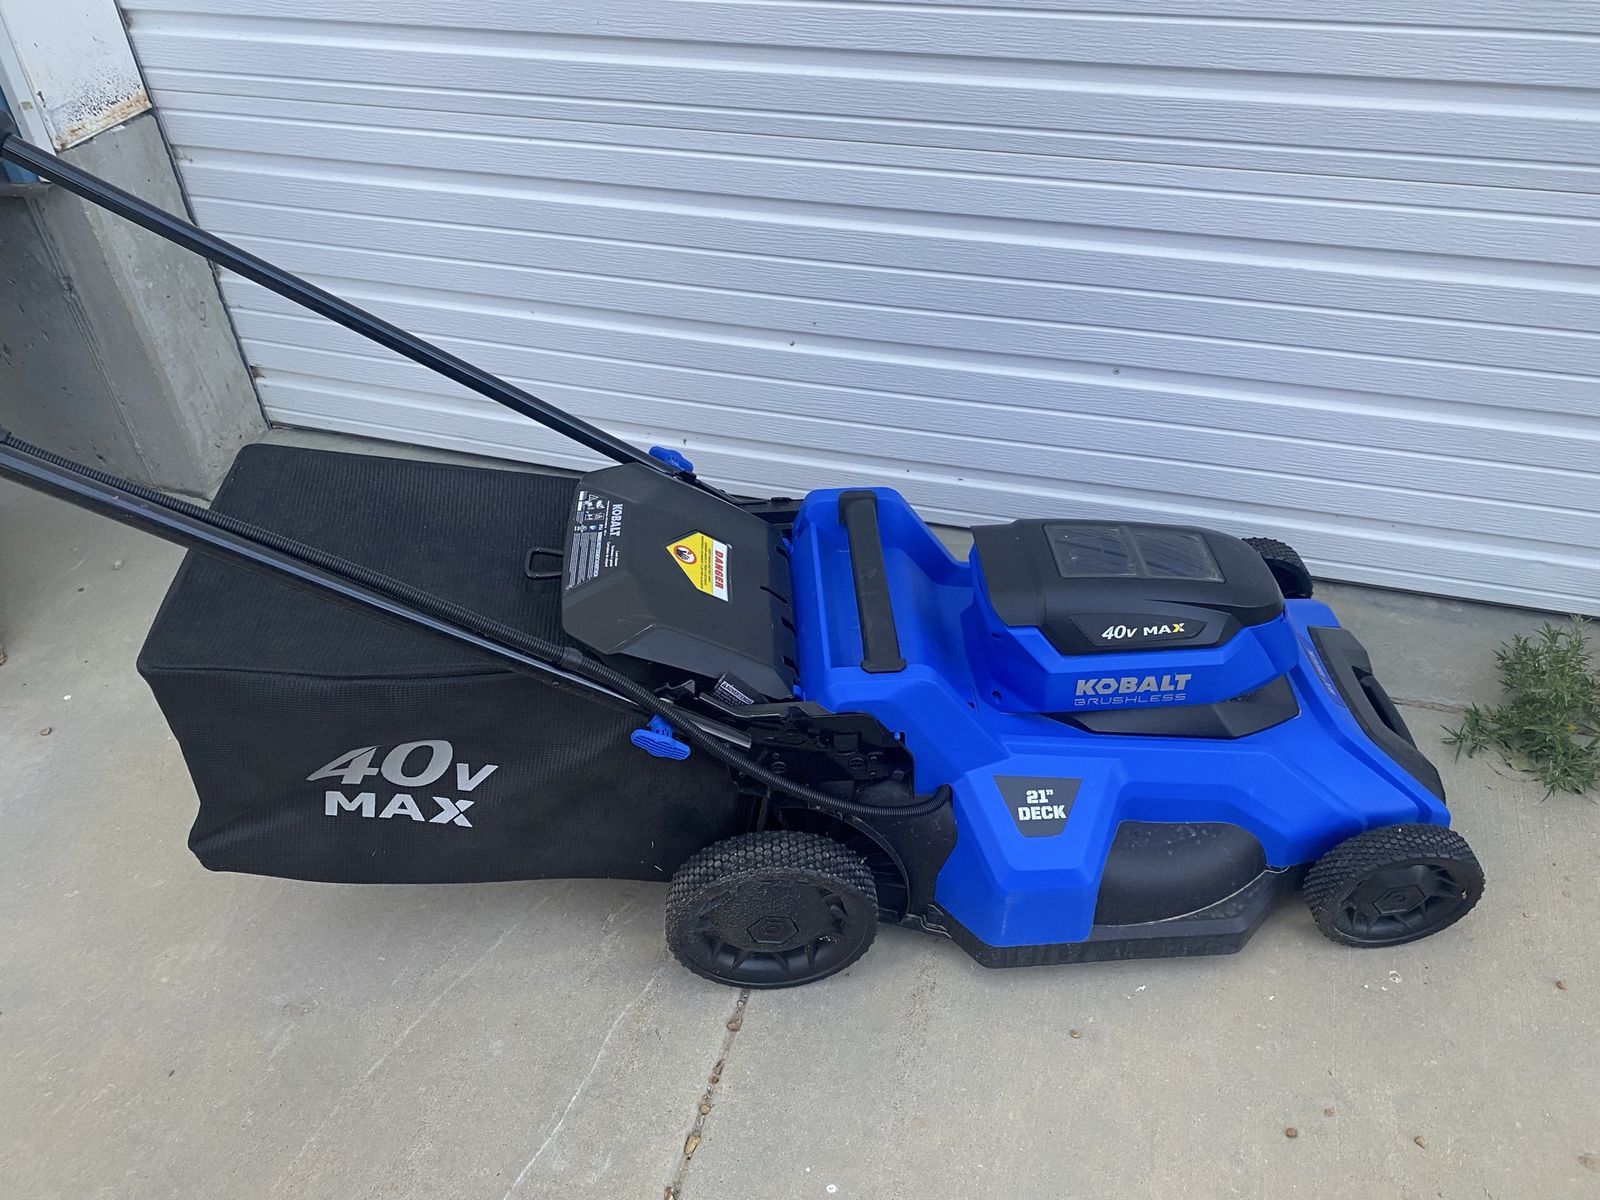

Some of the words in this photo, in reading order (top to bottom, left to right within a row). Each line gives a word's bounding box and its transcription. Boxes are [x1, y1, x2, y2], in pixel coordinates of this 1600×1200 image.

[611, 503, 624, 537] KOBALT
[714, 549, 724, 590] DANGER
[1143, 622, 1185, 636] MAX
[1075, 673, 1192, 696] KOBALT
[1074, 693, 1187, 706] BRUSHLESS
[325, 790, 475, 828] MAX
[1017, 804, 1067, 821] DECK
